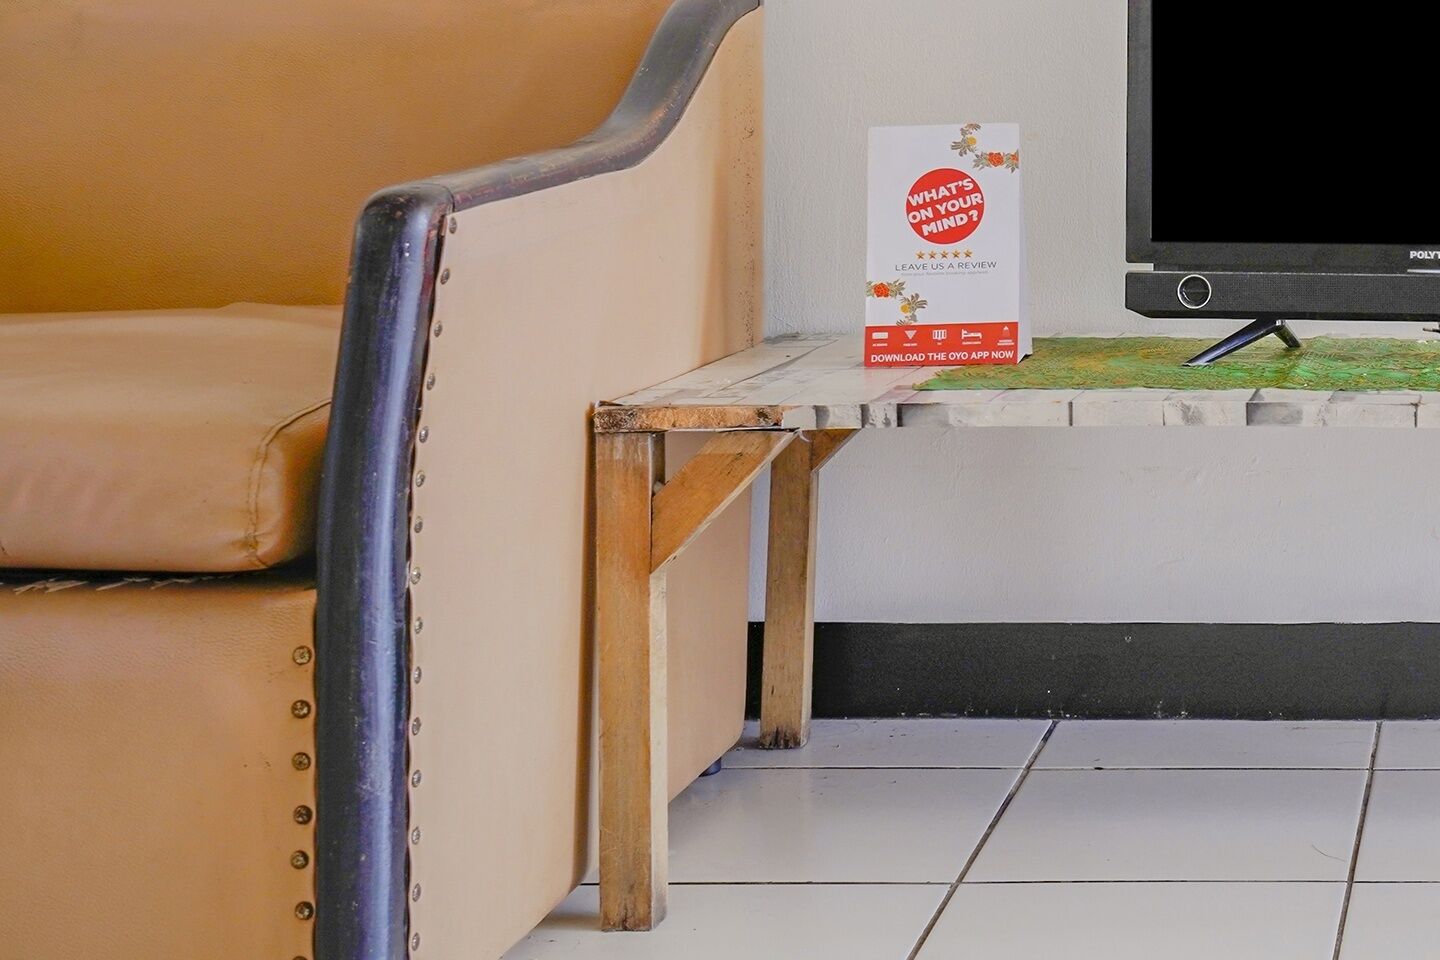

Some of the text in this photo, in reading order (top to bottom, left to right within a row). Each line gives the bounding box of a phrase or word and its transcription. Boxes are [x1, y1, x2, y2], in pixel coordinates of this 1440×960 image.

[908, 178, 974, 207] WHAT'S
[908, 192, 983, 224] ON YOUR
[895, 261, 997, 271] LEAVE US A REVIEW
[871, 350, 1014, 363] DOWNLOAD THE OYO APP NOW
